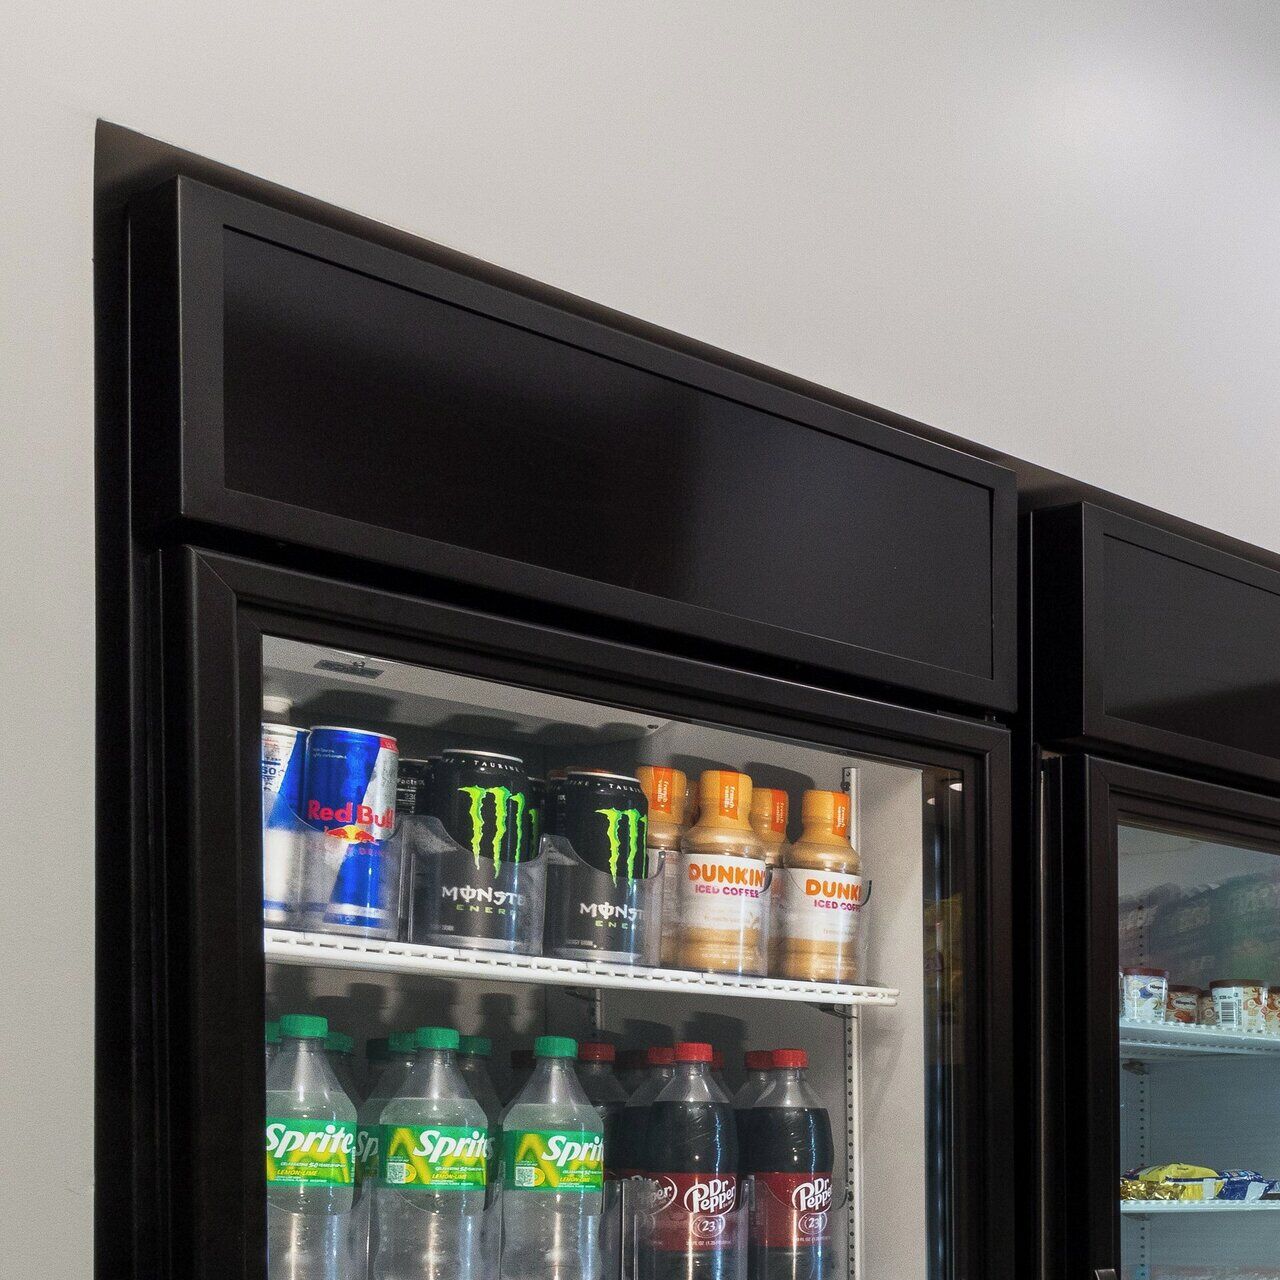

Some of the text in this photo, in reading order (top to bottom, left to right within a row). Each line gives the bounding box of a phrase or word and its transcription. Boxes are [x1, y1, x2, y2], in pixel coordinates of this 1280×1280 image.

[308, 800, 395, 829] Red Bull
[695, 884, 760, 898] ICED COFFEE
[815, 899, 838, 909] ICED
[266, 1122, 354, 1158] Sprite
[709, 1178, 729, 1196] Dr
[813, 1177, 830, 1194] Dr
[685, 1183, 736, 1214] Pepper
[702, 1220, 716, 1232] 23
